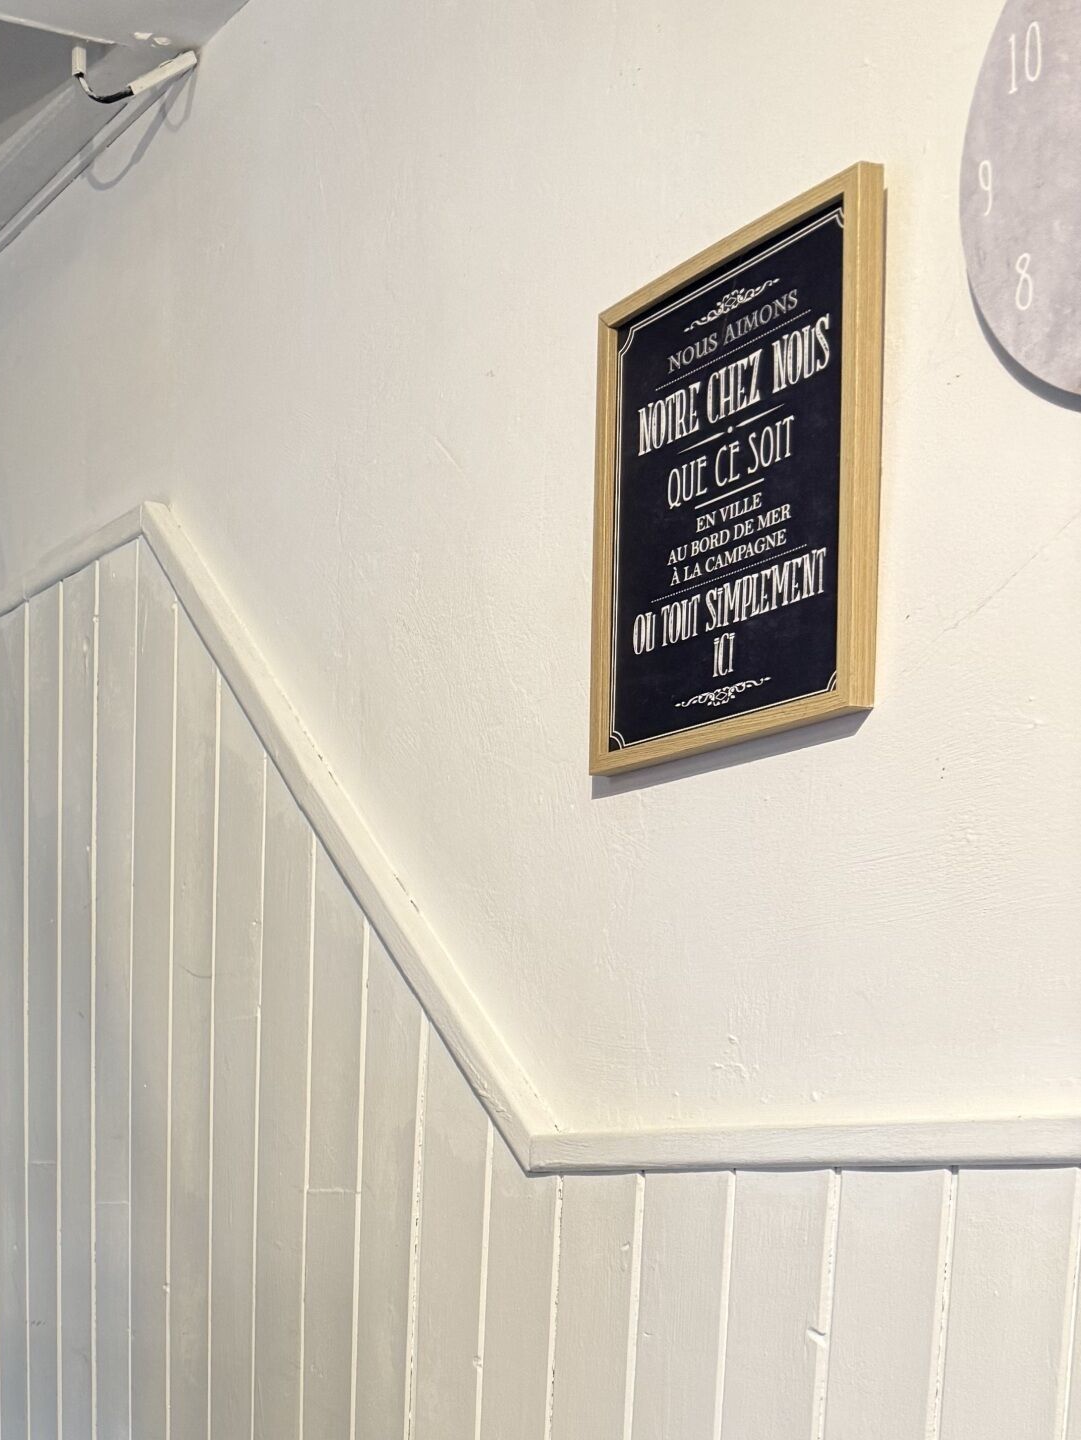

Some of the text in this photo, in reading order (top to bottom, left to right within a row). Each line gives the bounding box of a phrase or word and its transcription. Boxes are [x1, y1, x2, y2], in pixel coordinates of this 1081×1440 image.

[1008, 21, 1042, 95] 10
[978, 160, 993, 217] 9
[1015, 252, 1034, 311] 8
[667, 288, 798, 374] NOUS AIMONS
[637, 313, 831, 456] NOTRE CHEZ NOUS
[667, 415, 795, 510] QUE CE SOIT
[667, 503, 792, 566] AU BORD DE MER
[695, 492, 762, 533] EN VILLE
[669, 528, 788, 587] À LA CAMPAGNE
[632, 611, 656, 656] OU
[660, 594, 702, 647] TOUT
